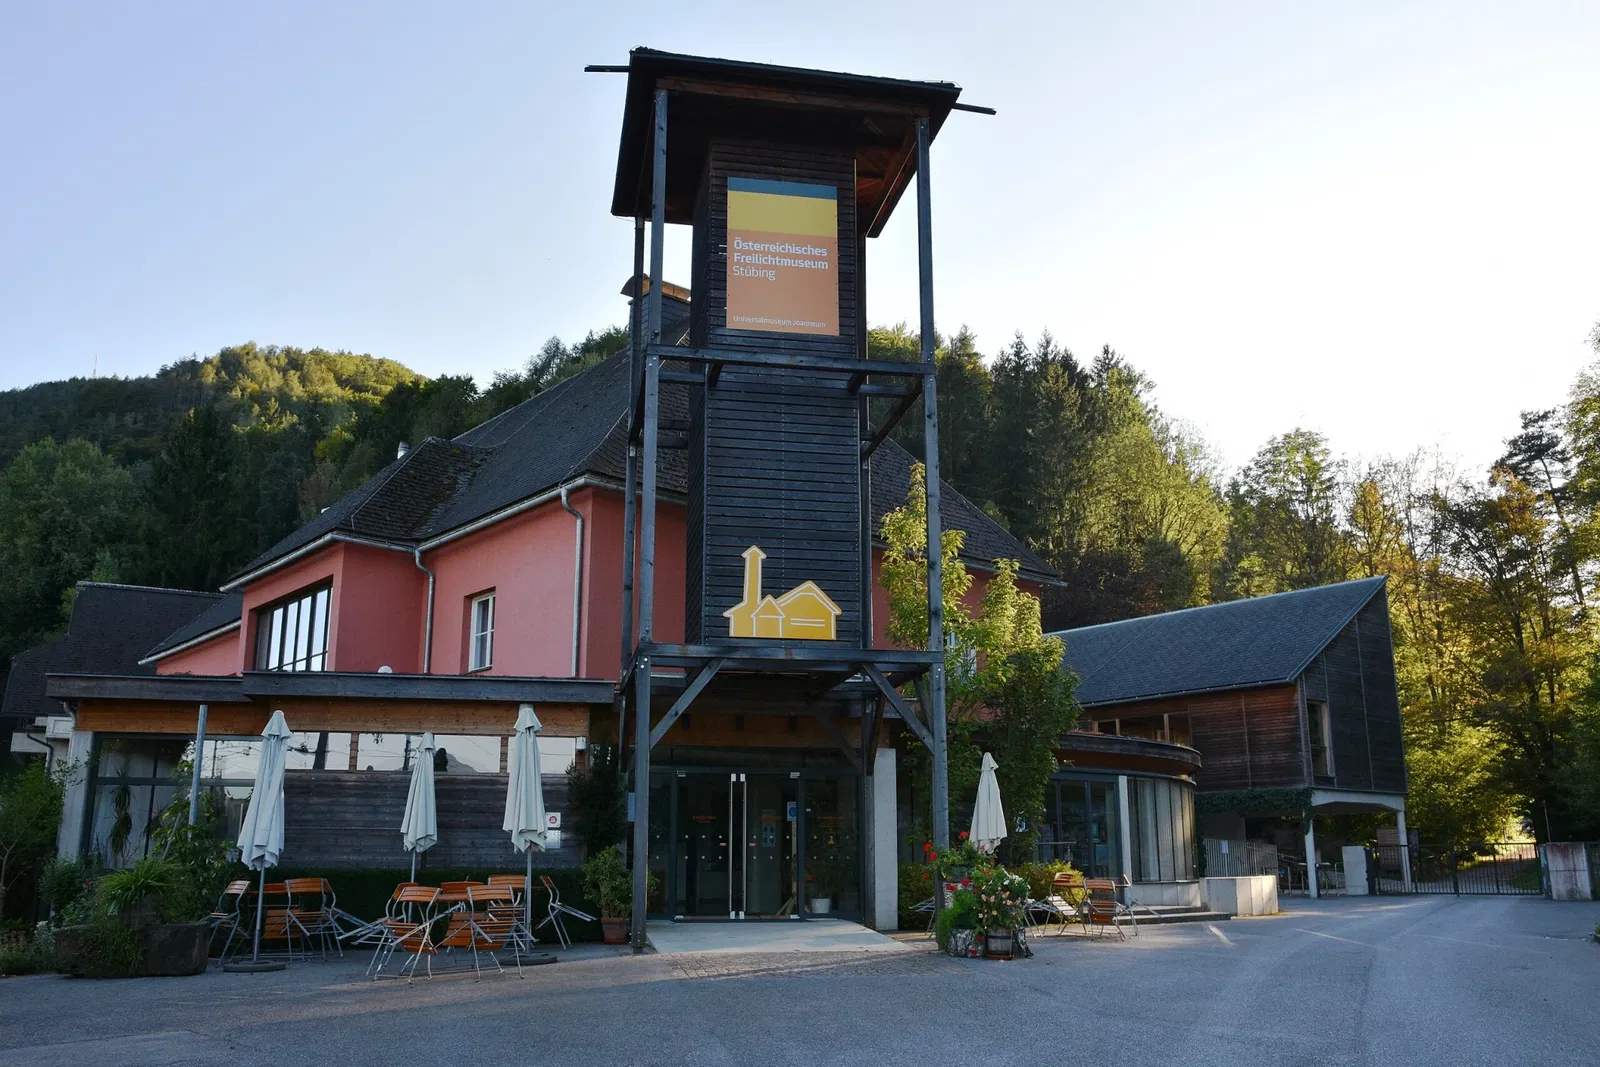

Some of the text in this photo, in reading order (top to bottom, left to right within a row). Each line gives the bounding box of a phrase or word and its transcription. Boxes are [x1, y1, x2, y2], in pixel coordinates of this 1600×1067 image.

[733, 236, 827, 256] Österreichisches
[733, 252, 828, 269] Freilichtmuseum
[732, 265, 776, 281] Stübing
[733, 315, 826, 328] Universalmuseum Joanneum
